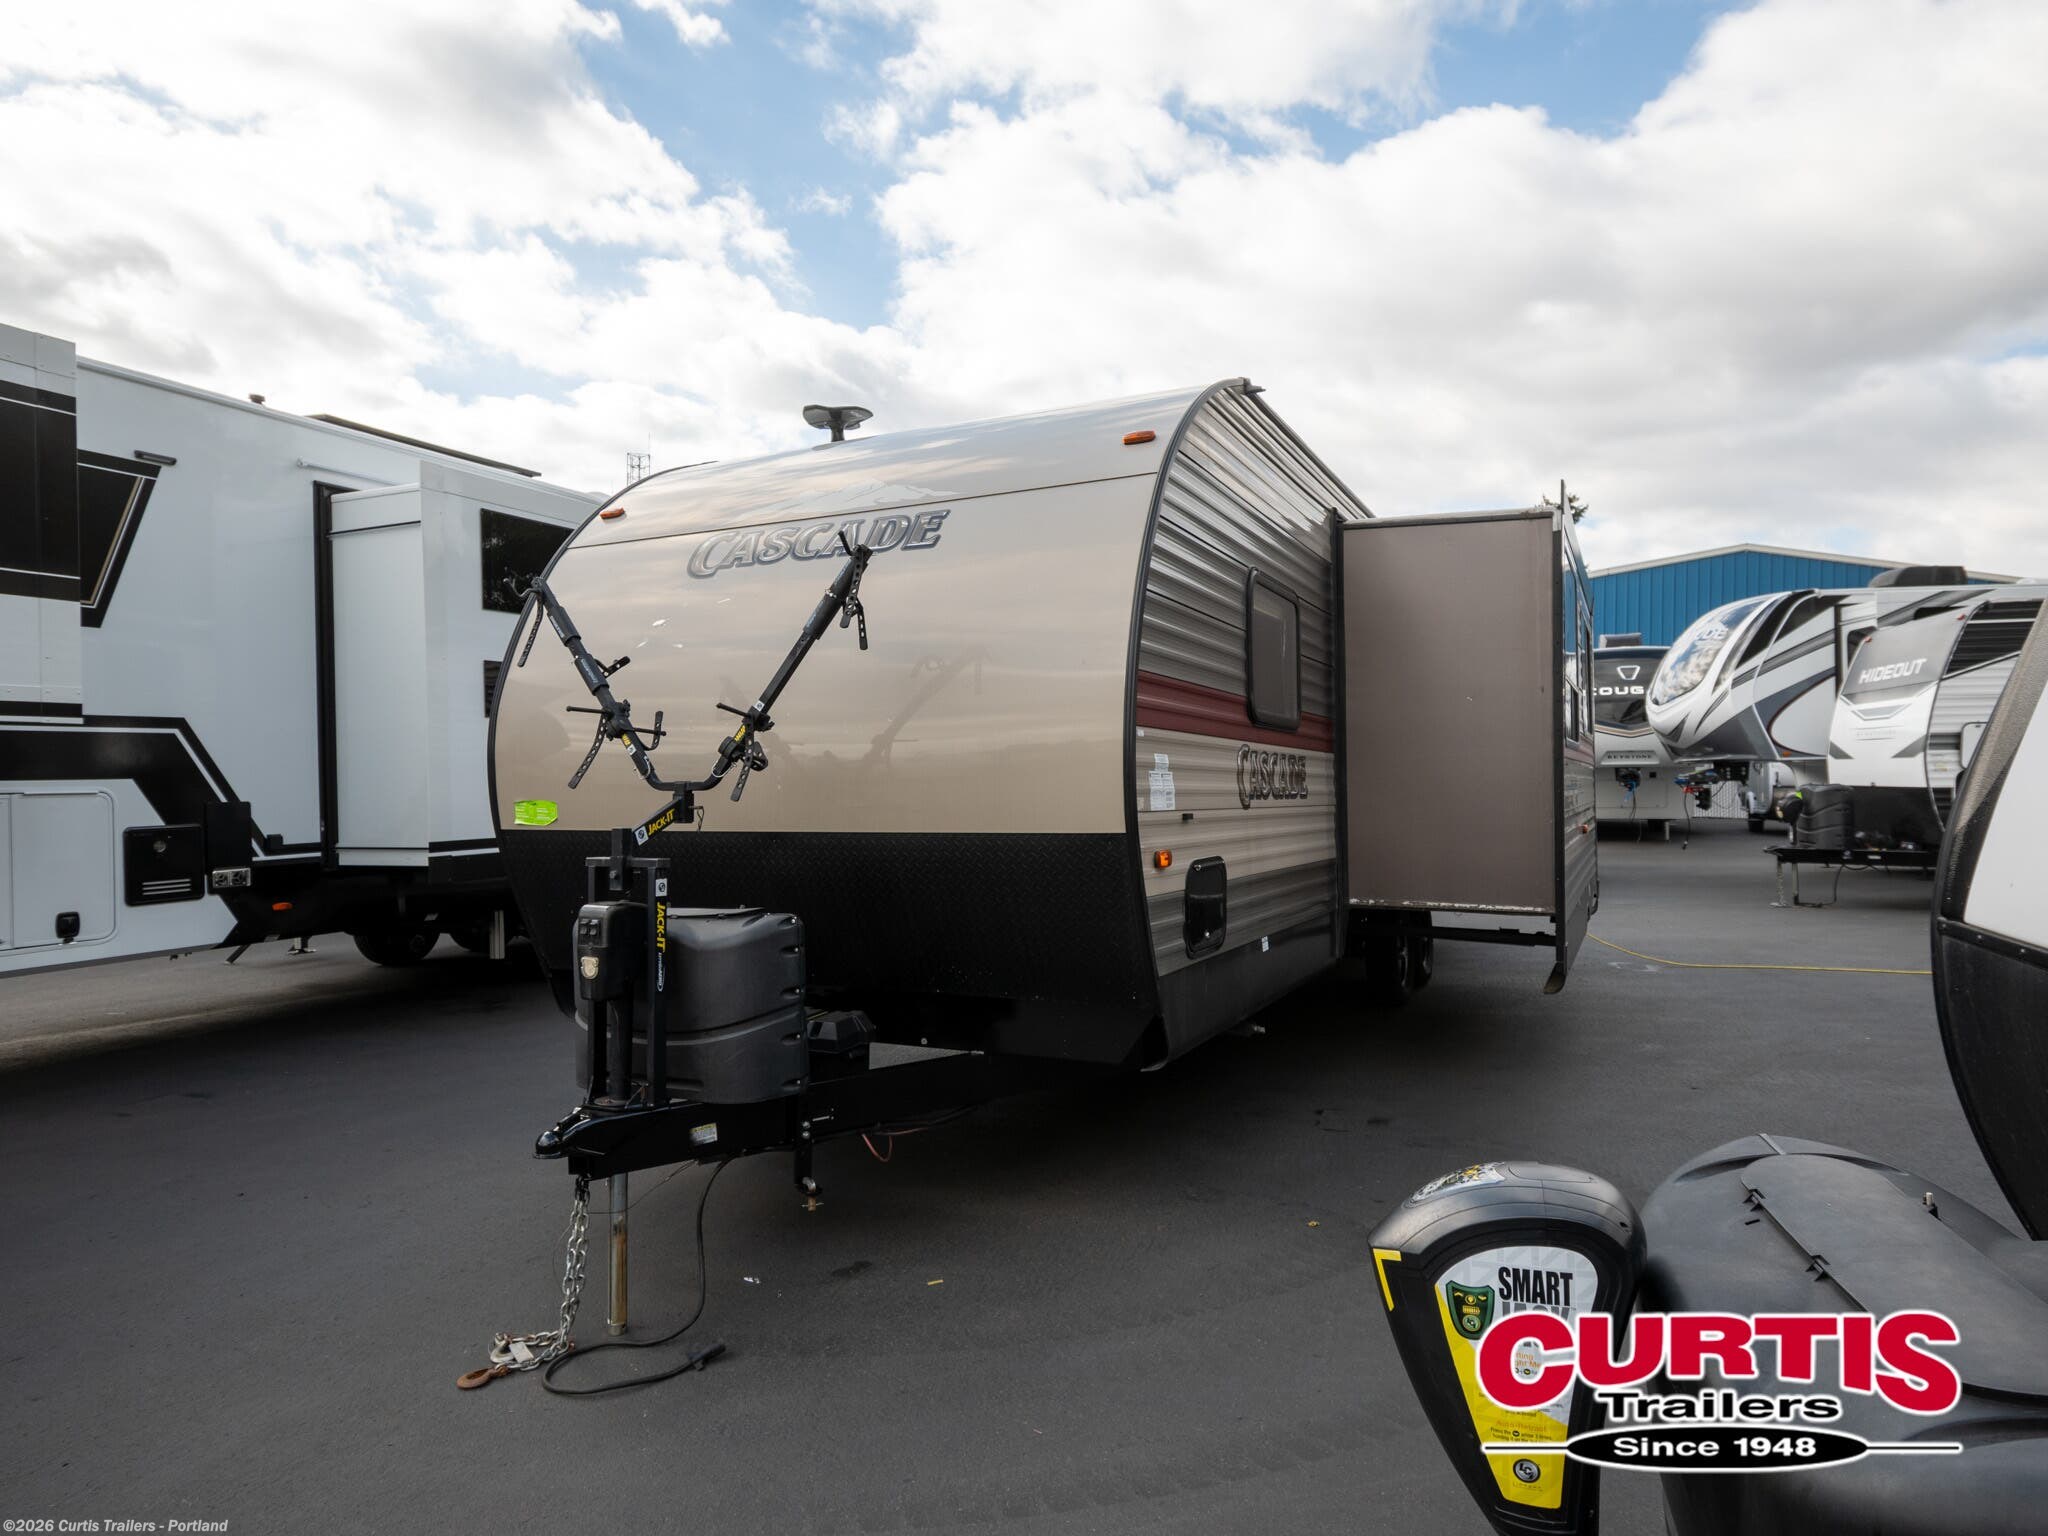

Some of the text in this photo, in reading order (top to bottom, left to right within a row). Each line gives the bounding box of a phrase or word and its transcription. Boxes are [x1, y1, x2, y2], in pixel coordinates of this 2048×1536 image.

[686, 509, 951, 579] CASCADE
[1858, 658, 1928, 684] HIDEOUT
[1236, 743, 1308, 810] CASCADE
[648, 808, 675, 836] JACK-IT
[656, 902, 666, 953] JACK-IT
[1498, 1266, 1573, 1306] SMART
